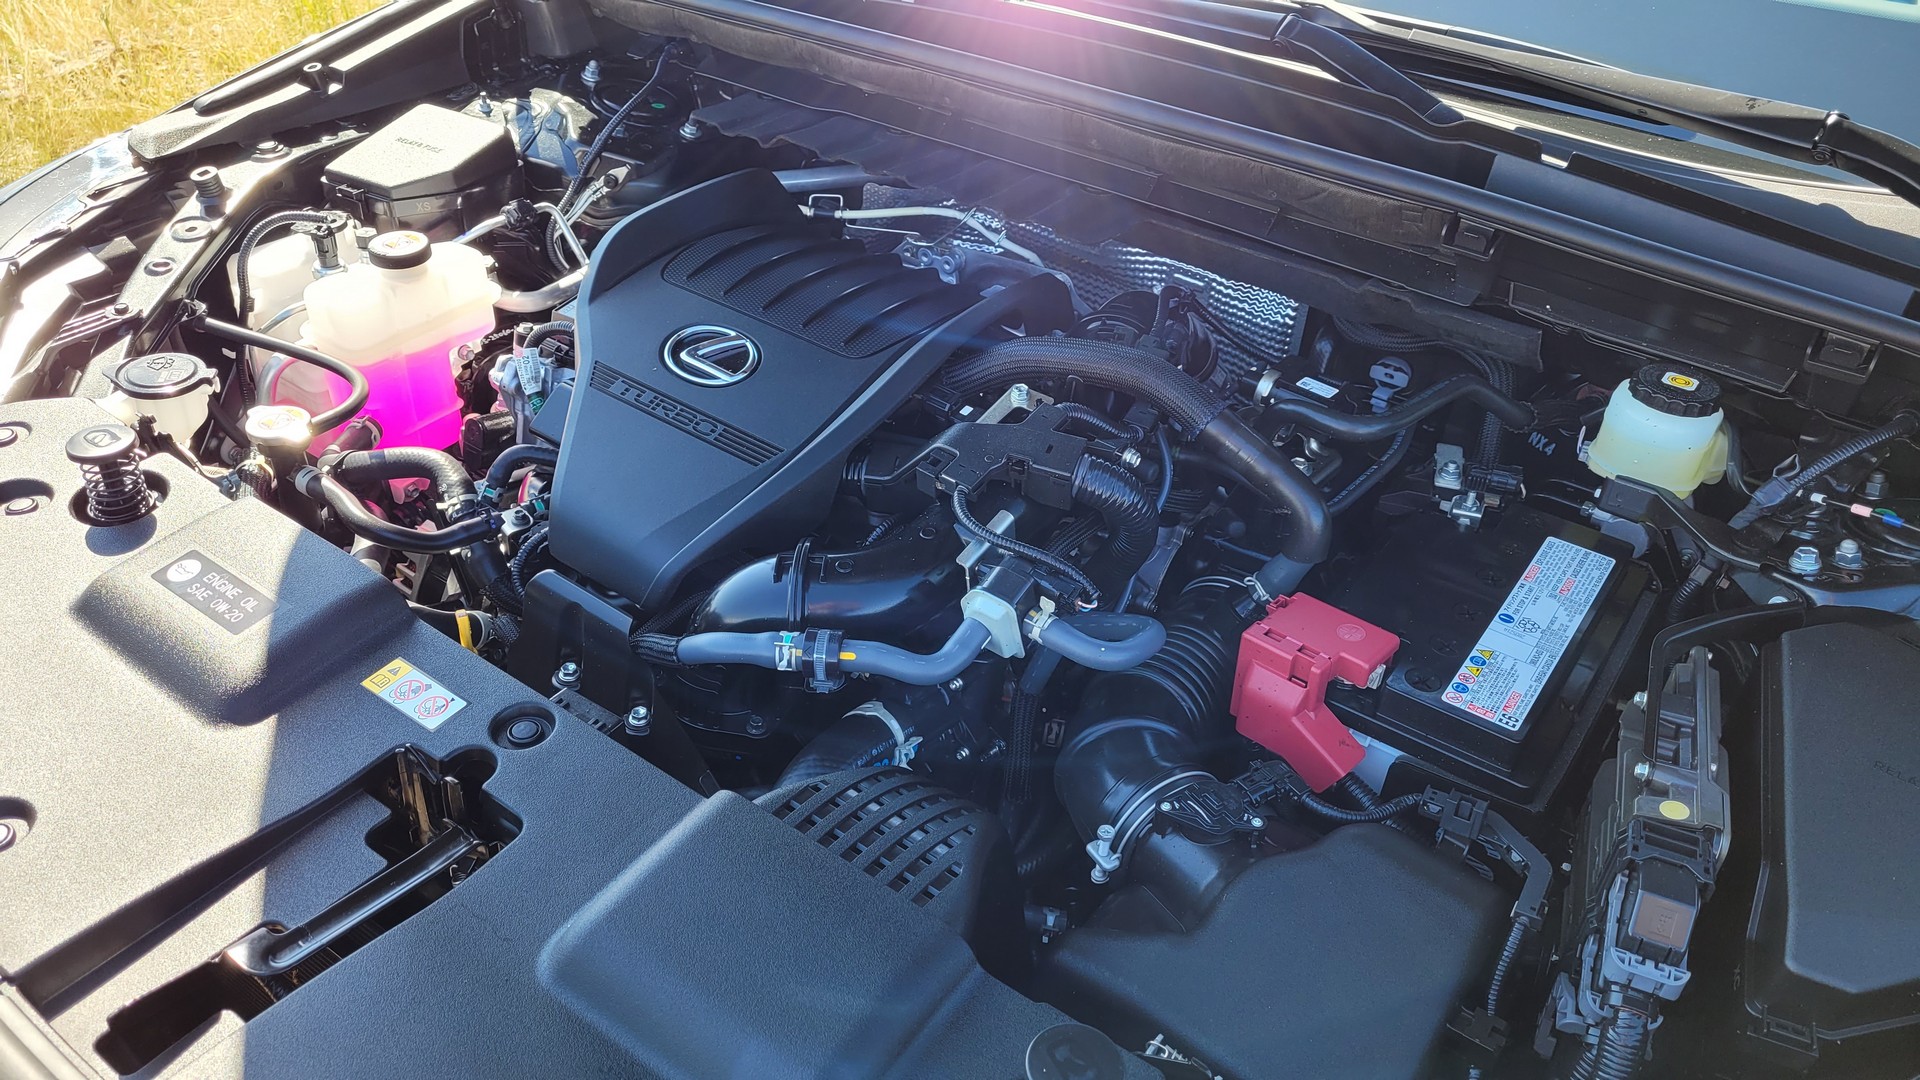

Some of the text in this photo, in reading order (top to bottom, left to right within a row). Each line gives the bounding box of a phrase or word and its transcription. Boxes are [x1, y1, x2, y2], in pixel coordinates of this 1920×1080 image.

[416, 201, 432, 212] XS
[611, 377, 722, 438] TURBO
[1528, 431, 1556, 456] NX4
[187, 583, 245, 623] SAE 0W-20
[202, 572, 260, 613] ENGINE OIL
[1498, 713, 1519, 728] E6
